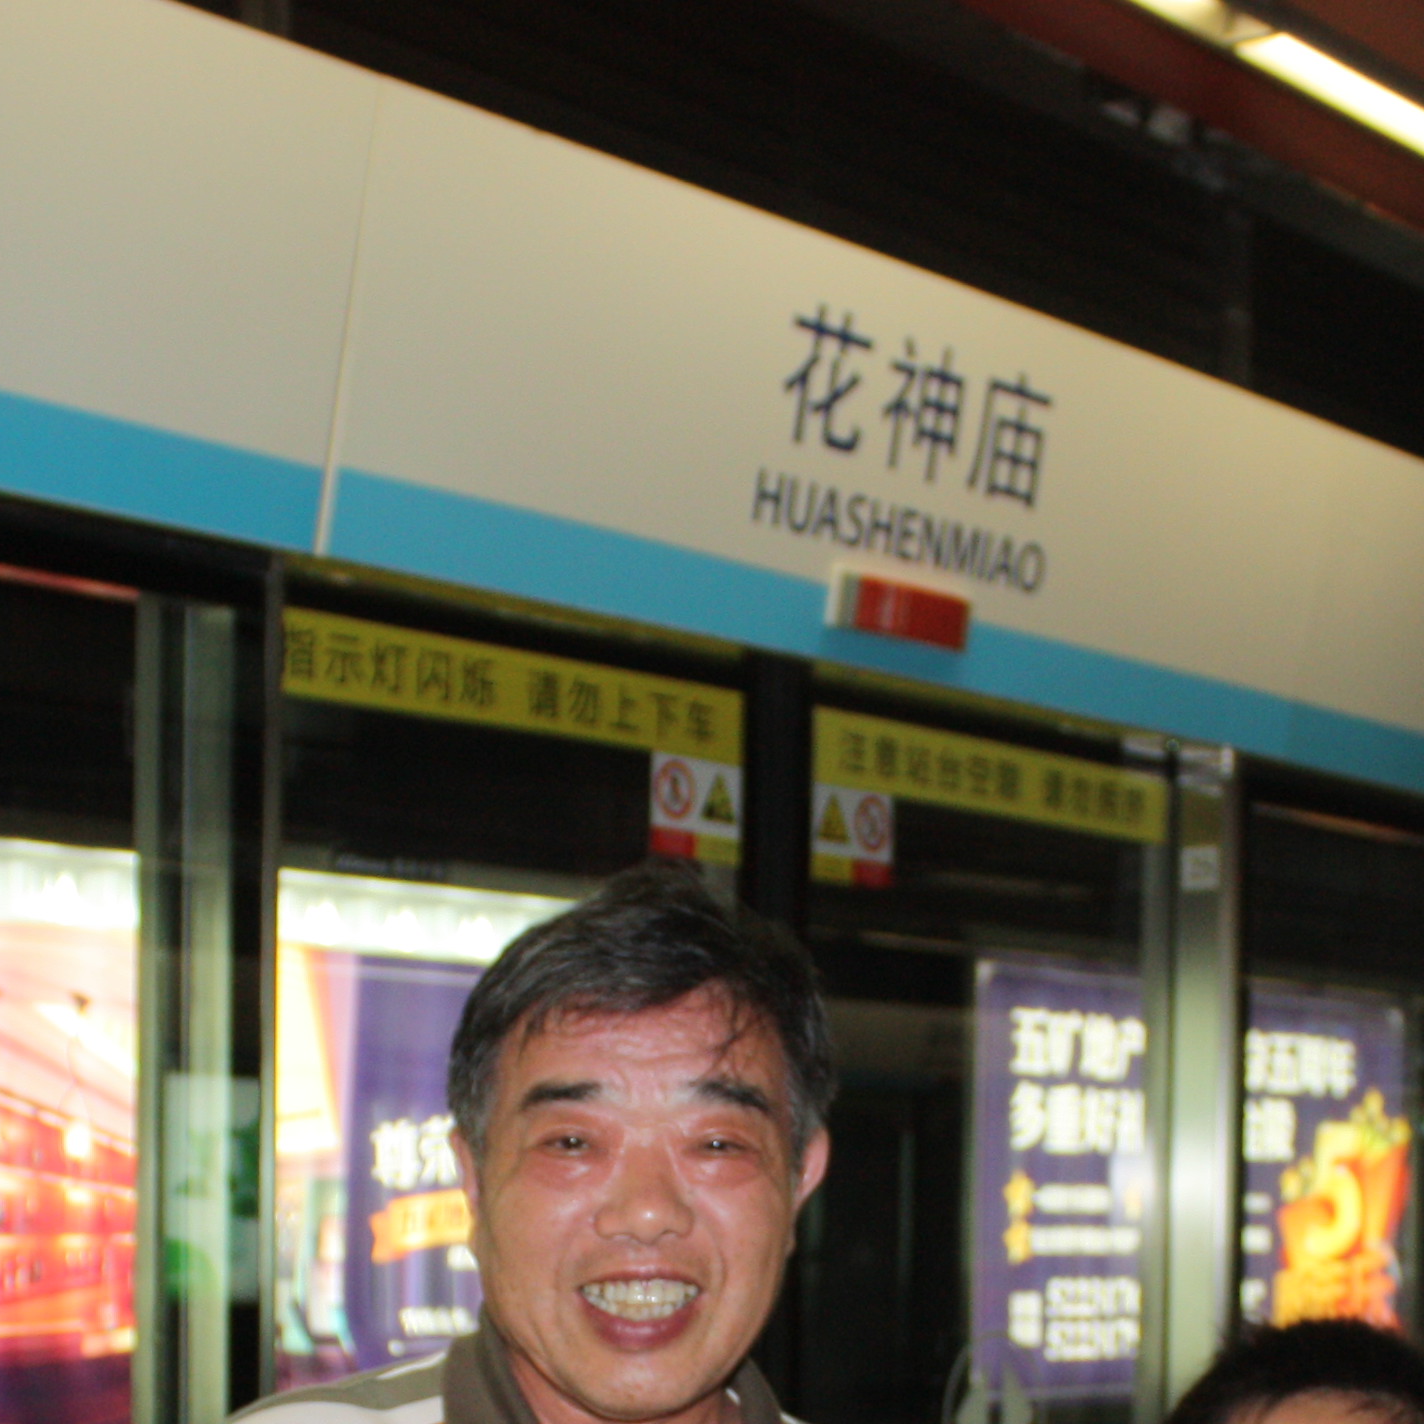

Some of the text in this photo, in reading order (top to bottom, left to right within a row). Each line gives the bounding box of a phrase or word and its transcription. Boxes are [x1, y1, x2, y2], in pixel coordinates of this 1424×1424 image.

[784, 303, 1053, 510] 花神庙
[751, 466, 1048, 595] HUASHENMIAO
